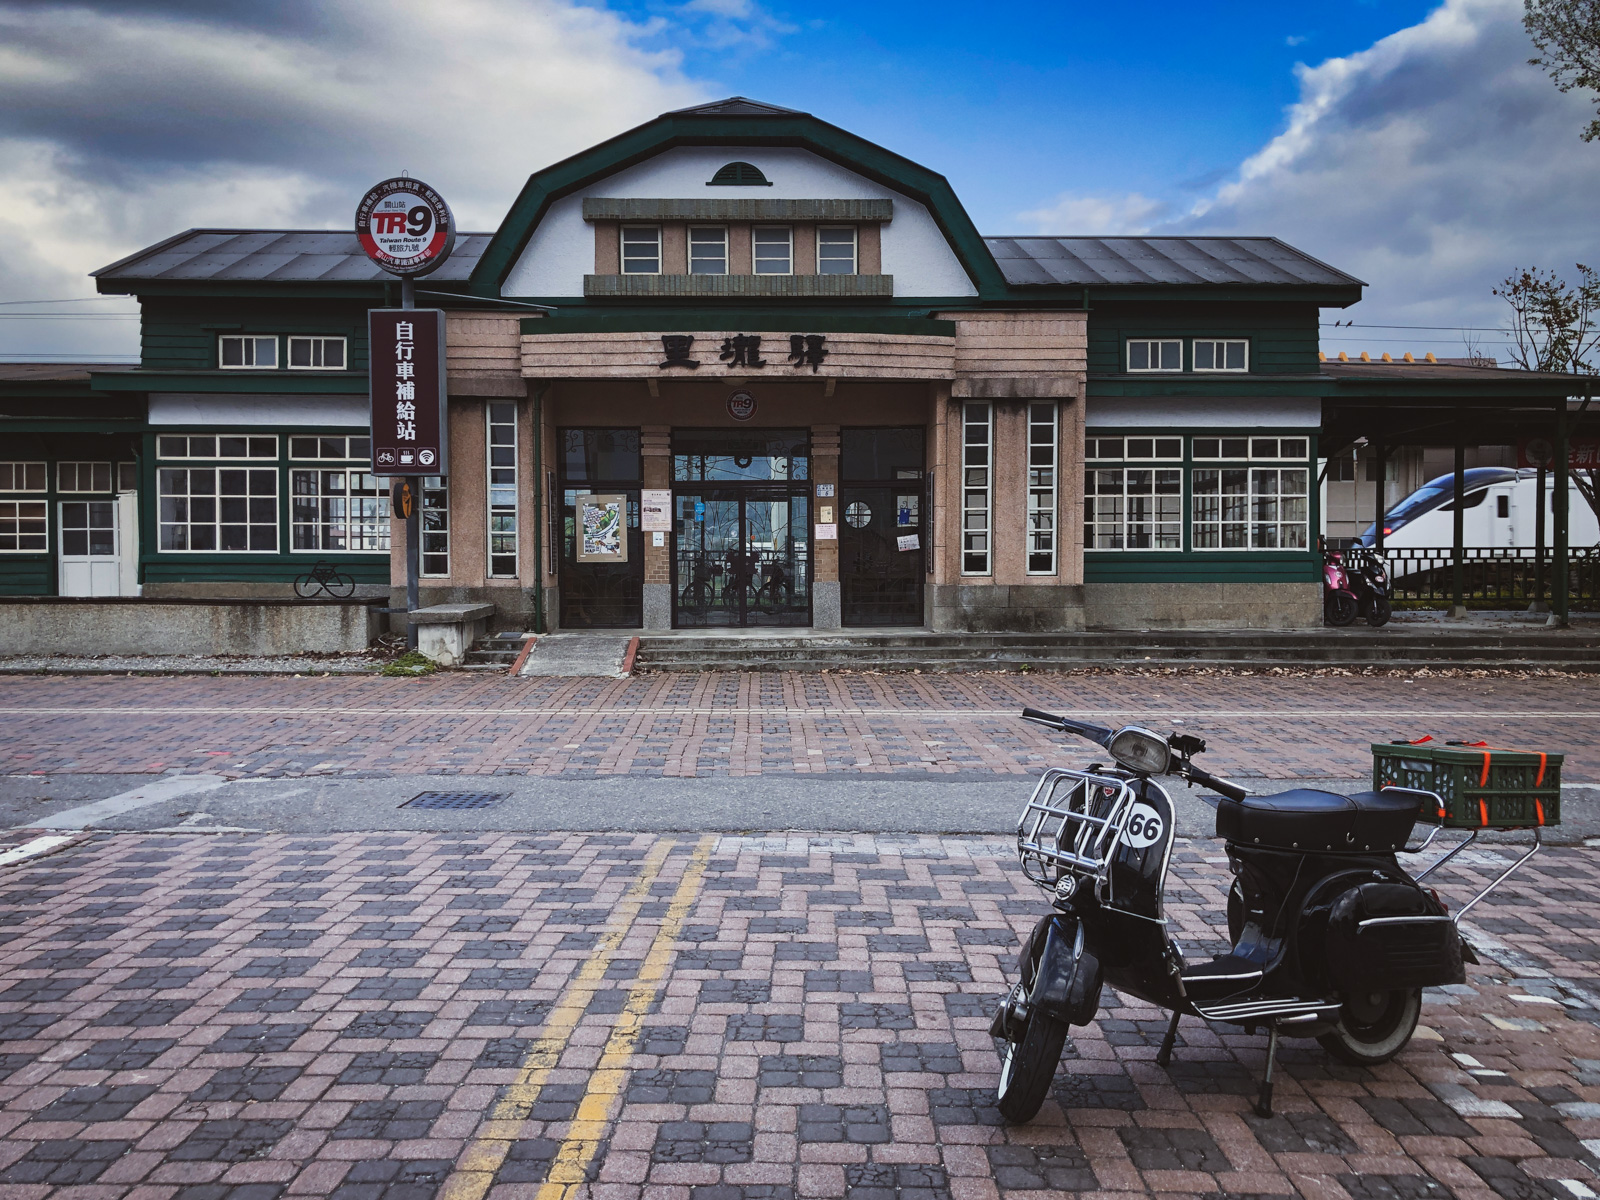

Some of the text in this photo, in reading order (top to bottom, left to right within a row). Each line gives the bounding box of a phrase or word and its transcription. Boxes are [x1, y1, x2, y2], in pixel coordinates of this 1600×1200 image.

[372, 206, 432, 236] TR9
[395, 321, 416, 441] 自行車補給站
[1129, 813, 1161, 841] 66
